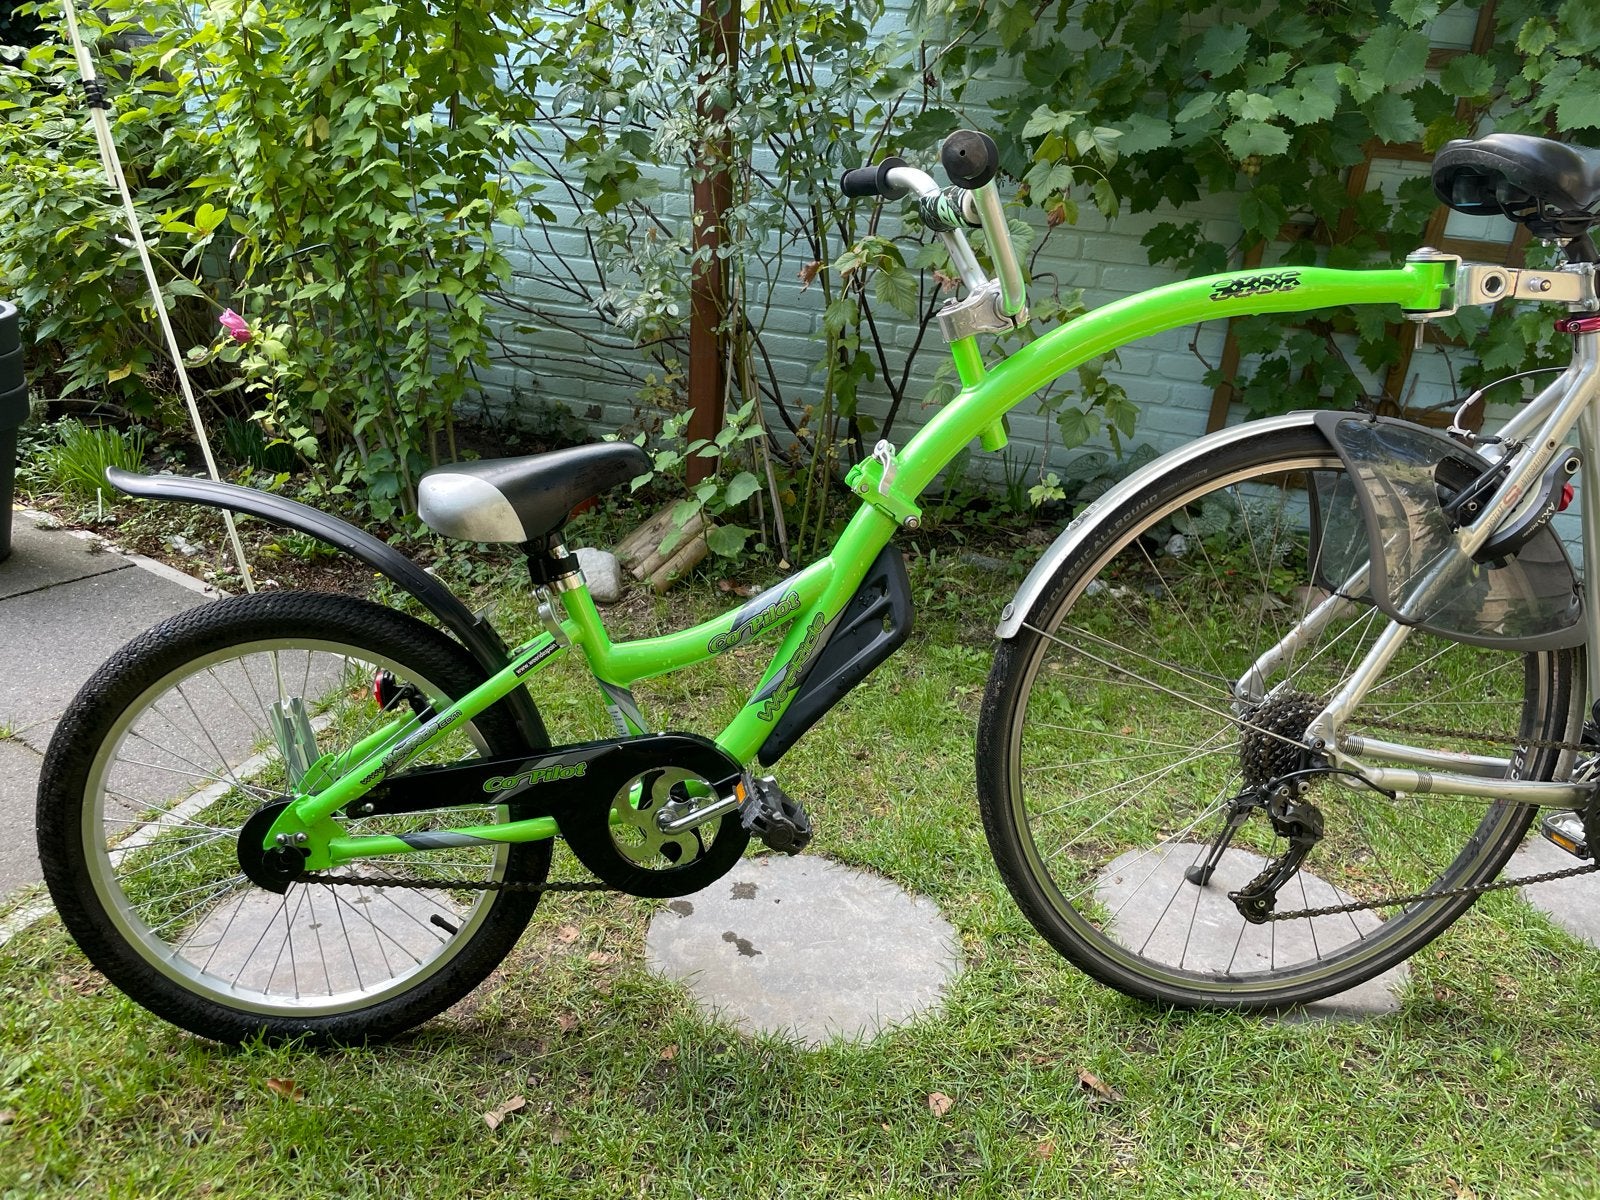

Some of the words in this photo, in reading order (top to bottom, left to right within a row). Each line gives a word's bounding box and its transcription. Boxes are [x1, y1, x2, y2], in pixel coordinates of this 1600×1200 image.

[1209, 280, 1300, 301] LINK
[1050, 548, 1091, 601] CLASSIC
[1094, 494, 1159, 550] ALLROUND
